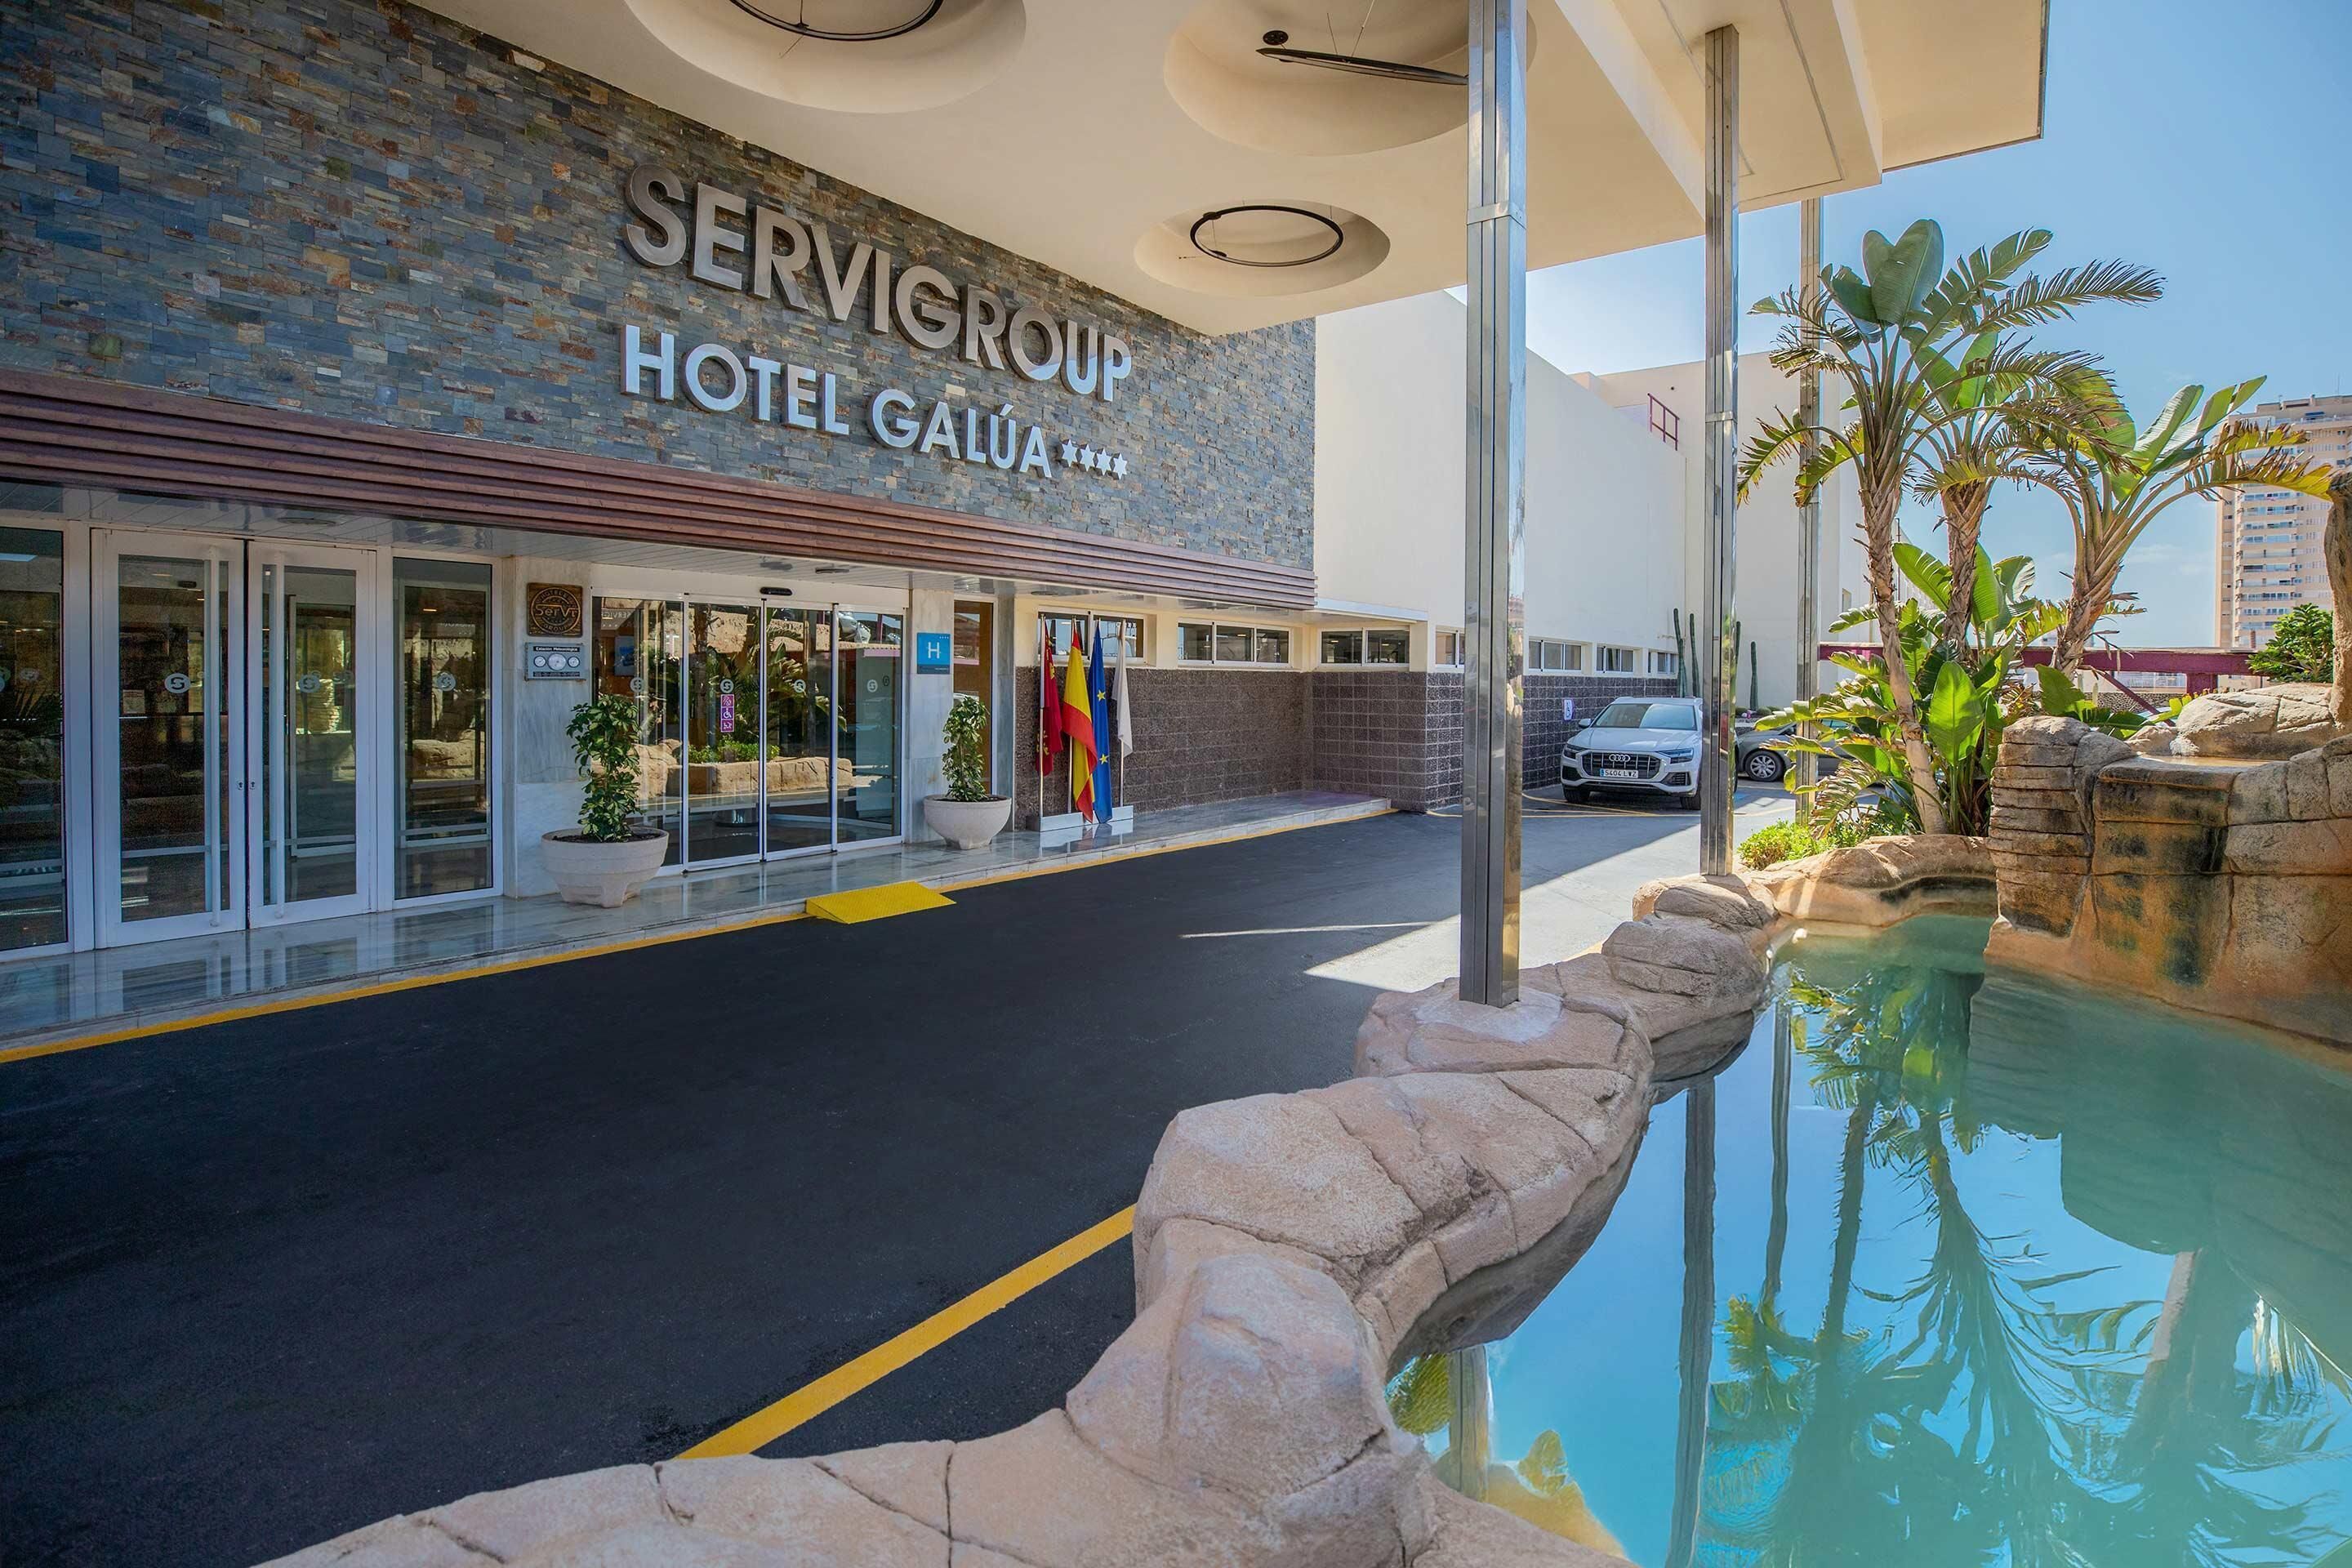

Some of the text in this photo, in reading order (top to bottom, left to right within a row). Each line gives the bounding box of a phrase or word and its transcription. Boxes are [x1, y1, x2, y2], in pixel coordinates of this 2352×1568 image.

[626, 166, 1131, 402] SERVIGROUP
[621, 324, 1053, 478] HOTEL GALÚA
[928, 641, 940, 659] H
